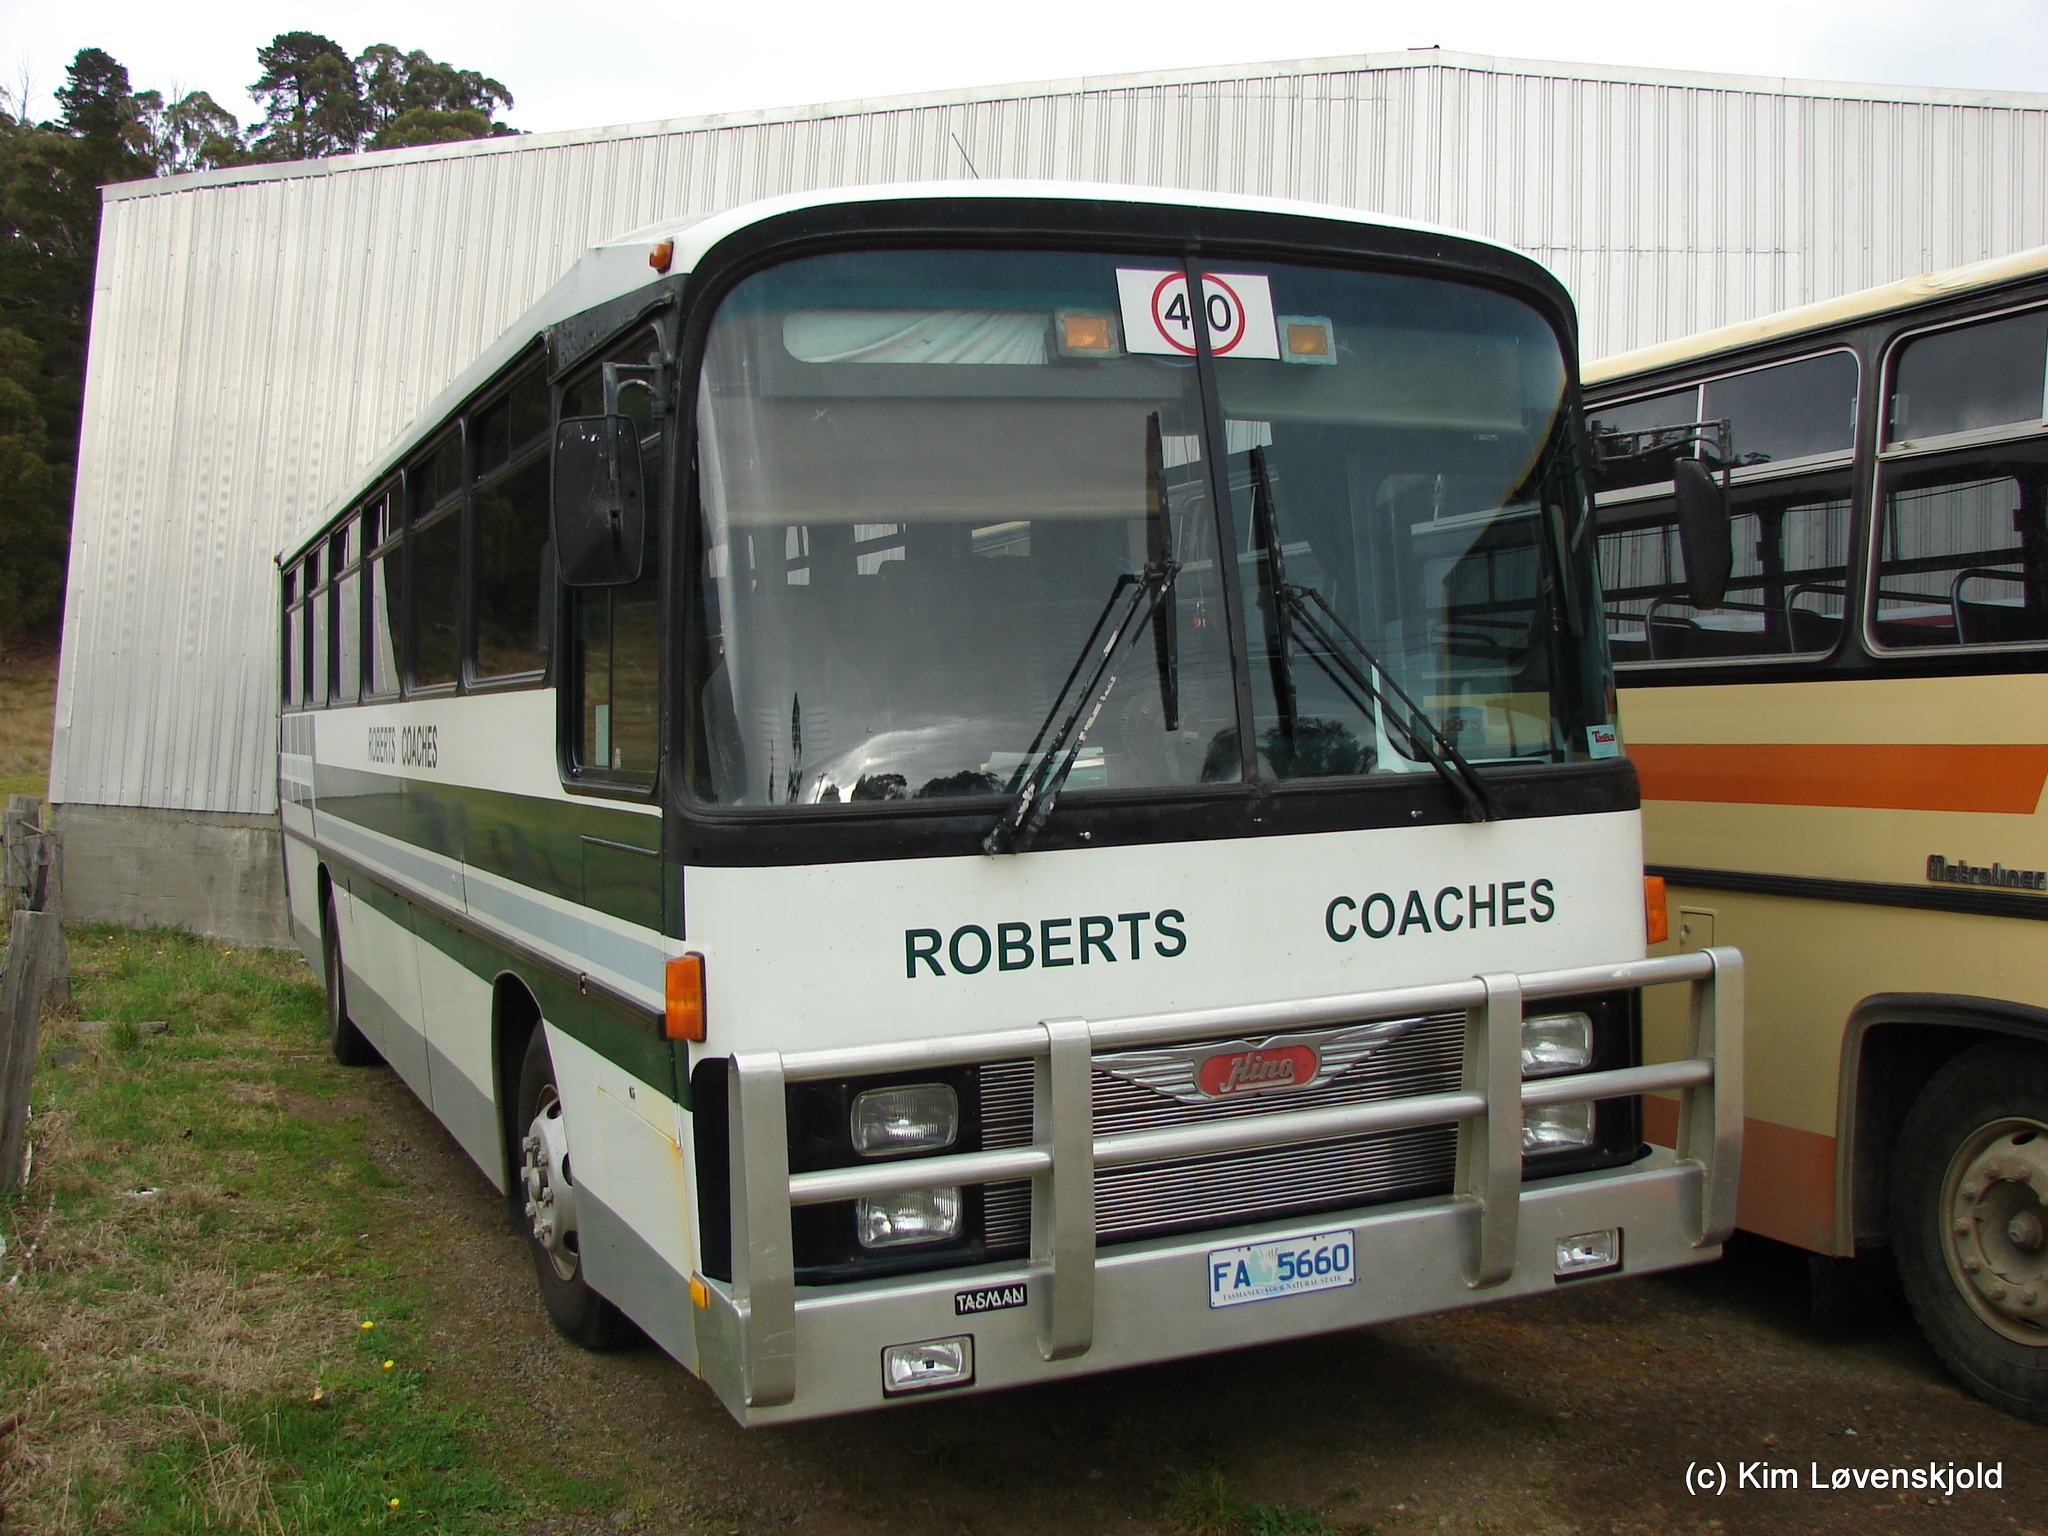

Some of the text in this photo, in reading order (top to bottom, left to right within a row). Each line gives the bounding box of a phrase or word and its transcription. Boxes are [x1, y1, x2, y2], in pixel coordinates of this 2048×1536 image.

[1164, 293, 1232, 332] 40
[368, 725, 438, 769] ROBERTS COACHES
[1926, 854, 2047, 890] Metroliner
[905, 878, 1555, 979] ROBERTS COACHES
[1219, 1051, 1295, 1093] Hino
[1213, 1243, 1350, 1292] FA 5660
[956, 1286, 1024, 1312] TASMAN
